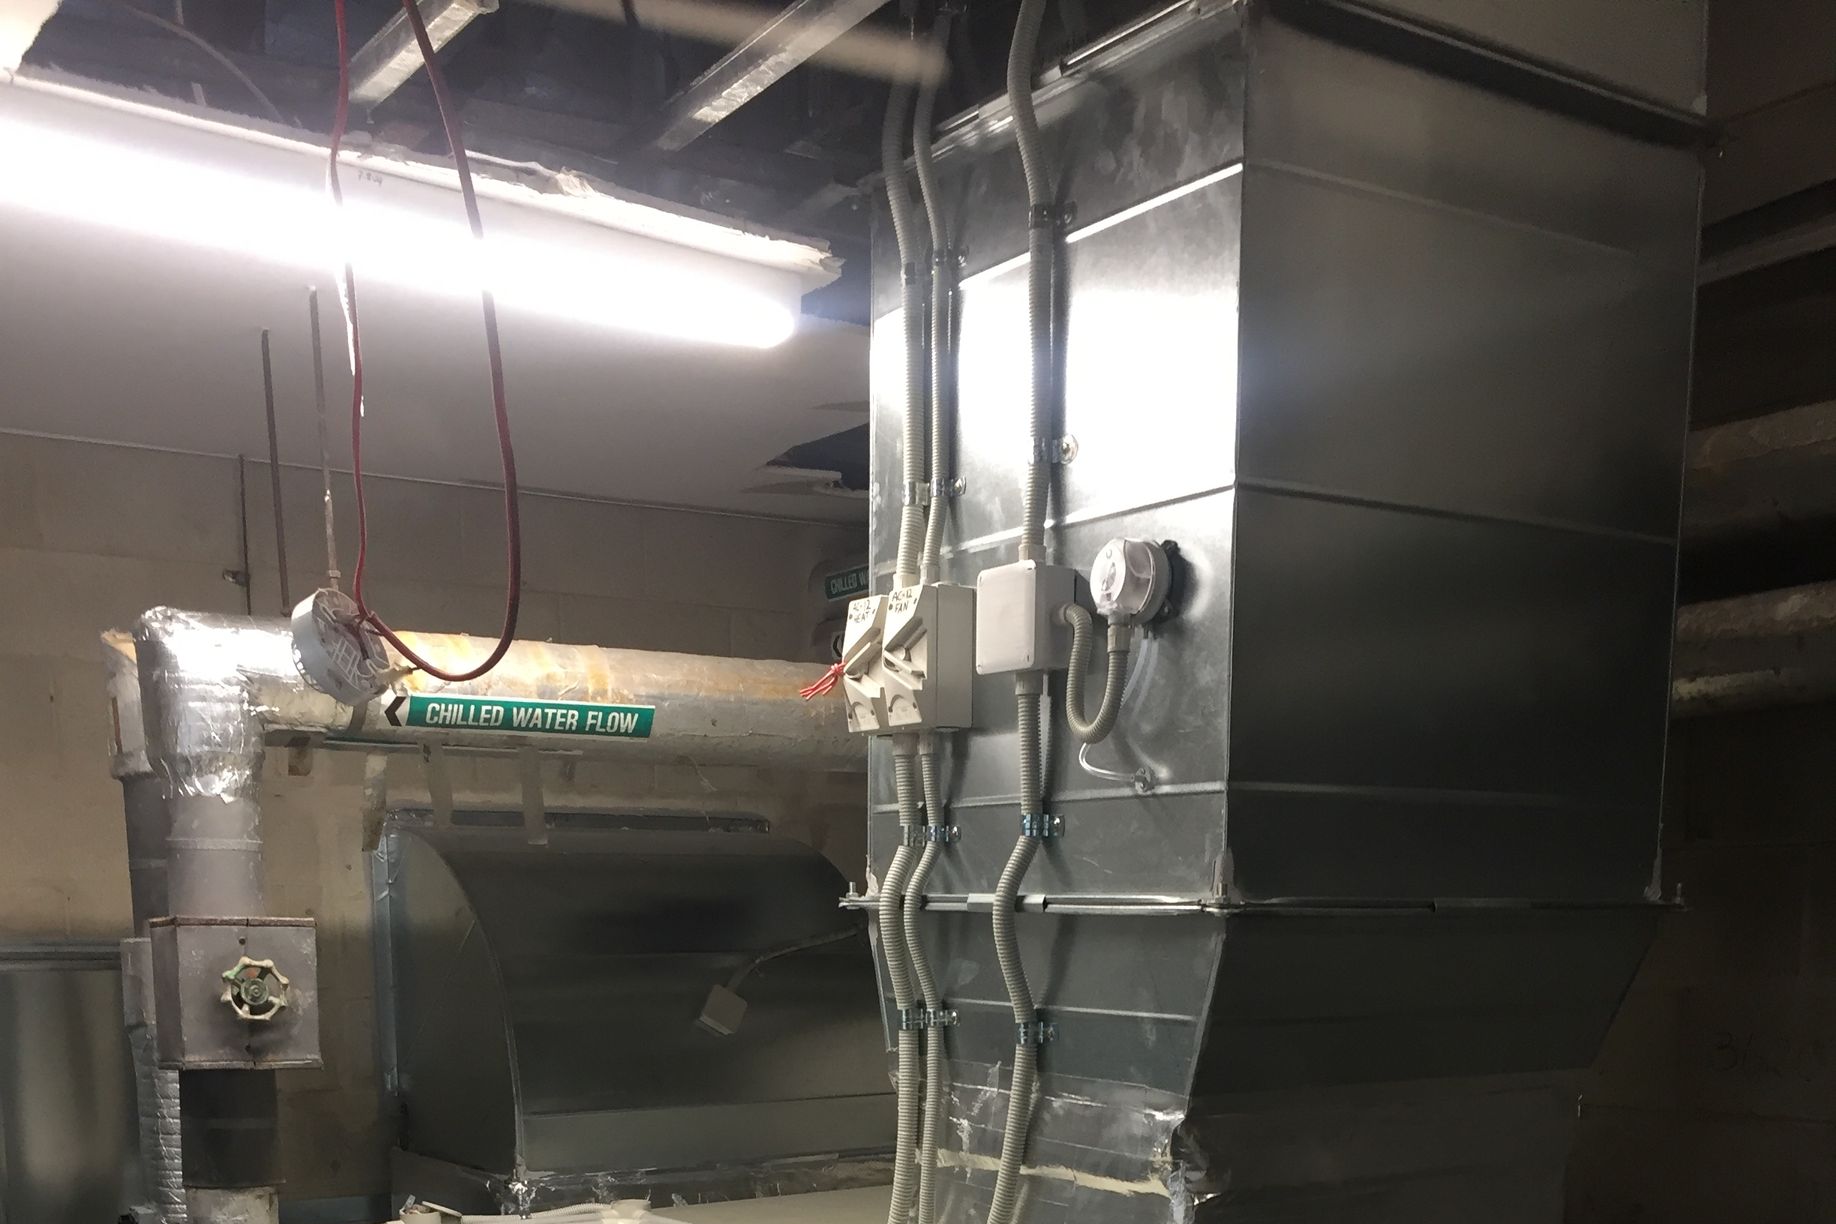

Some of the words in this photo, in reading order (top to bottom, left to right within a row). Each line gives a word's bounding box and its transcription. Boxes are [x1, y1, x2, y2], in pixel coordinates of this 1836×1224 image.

[830, 573, 858, 595] CHILLED
[895, 602, 909, 613] FAN
[425, 703, 504, 727] CHILLED
[512, 706, 578, 731] WATER
[585, 711, 639, 733] FLOW
